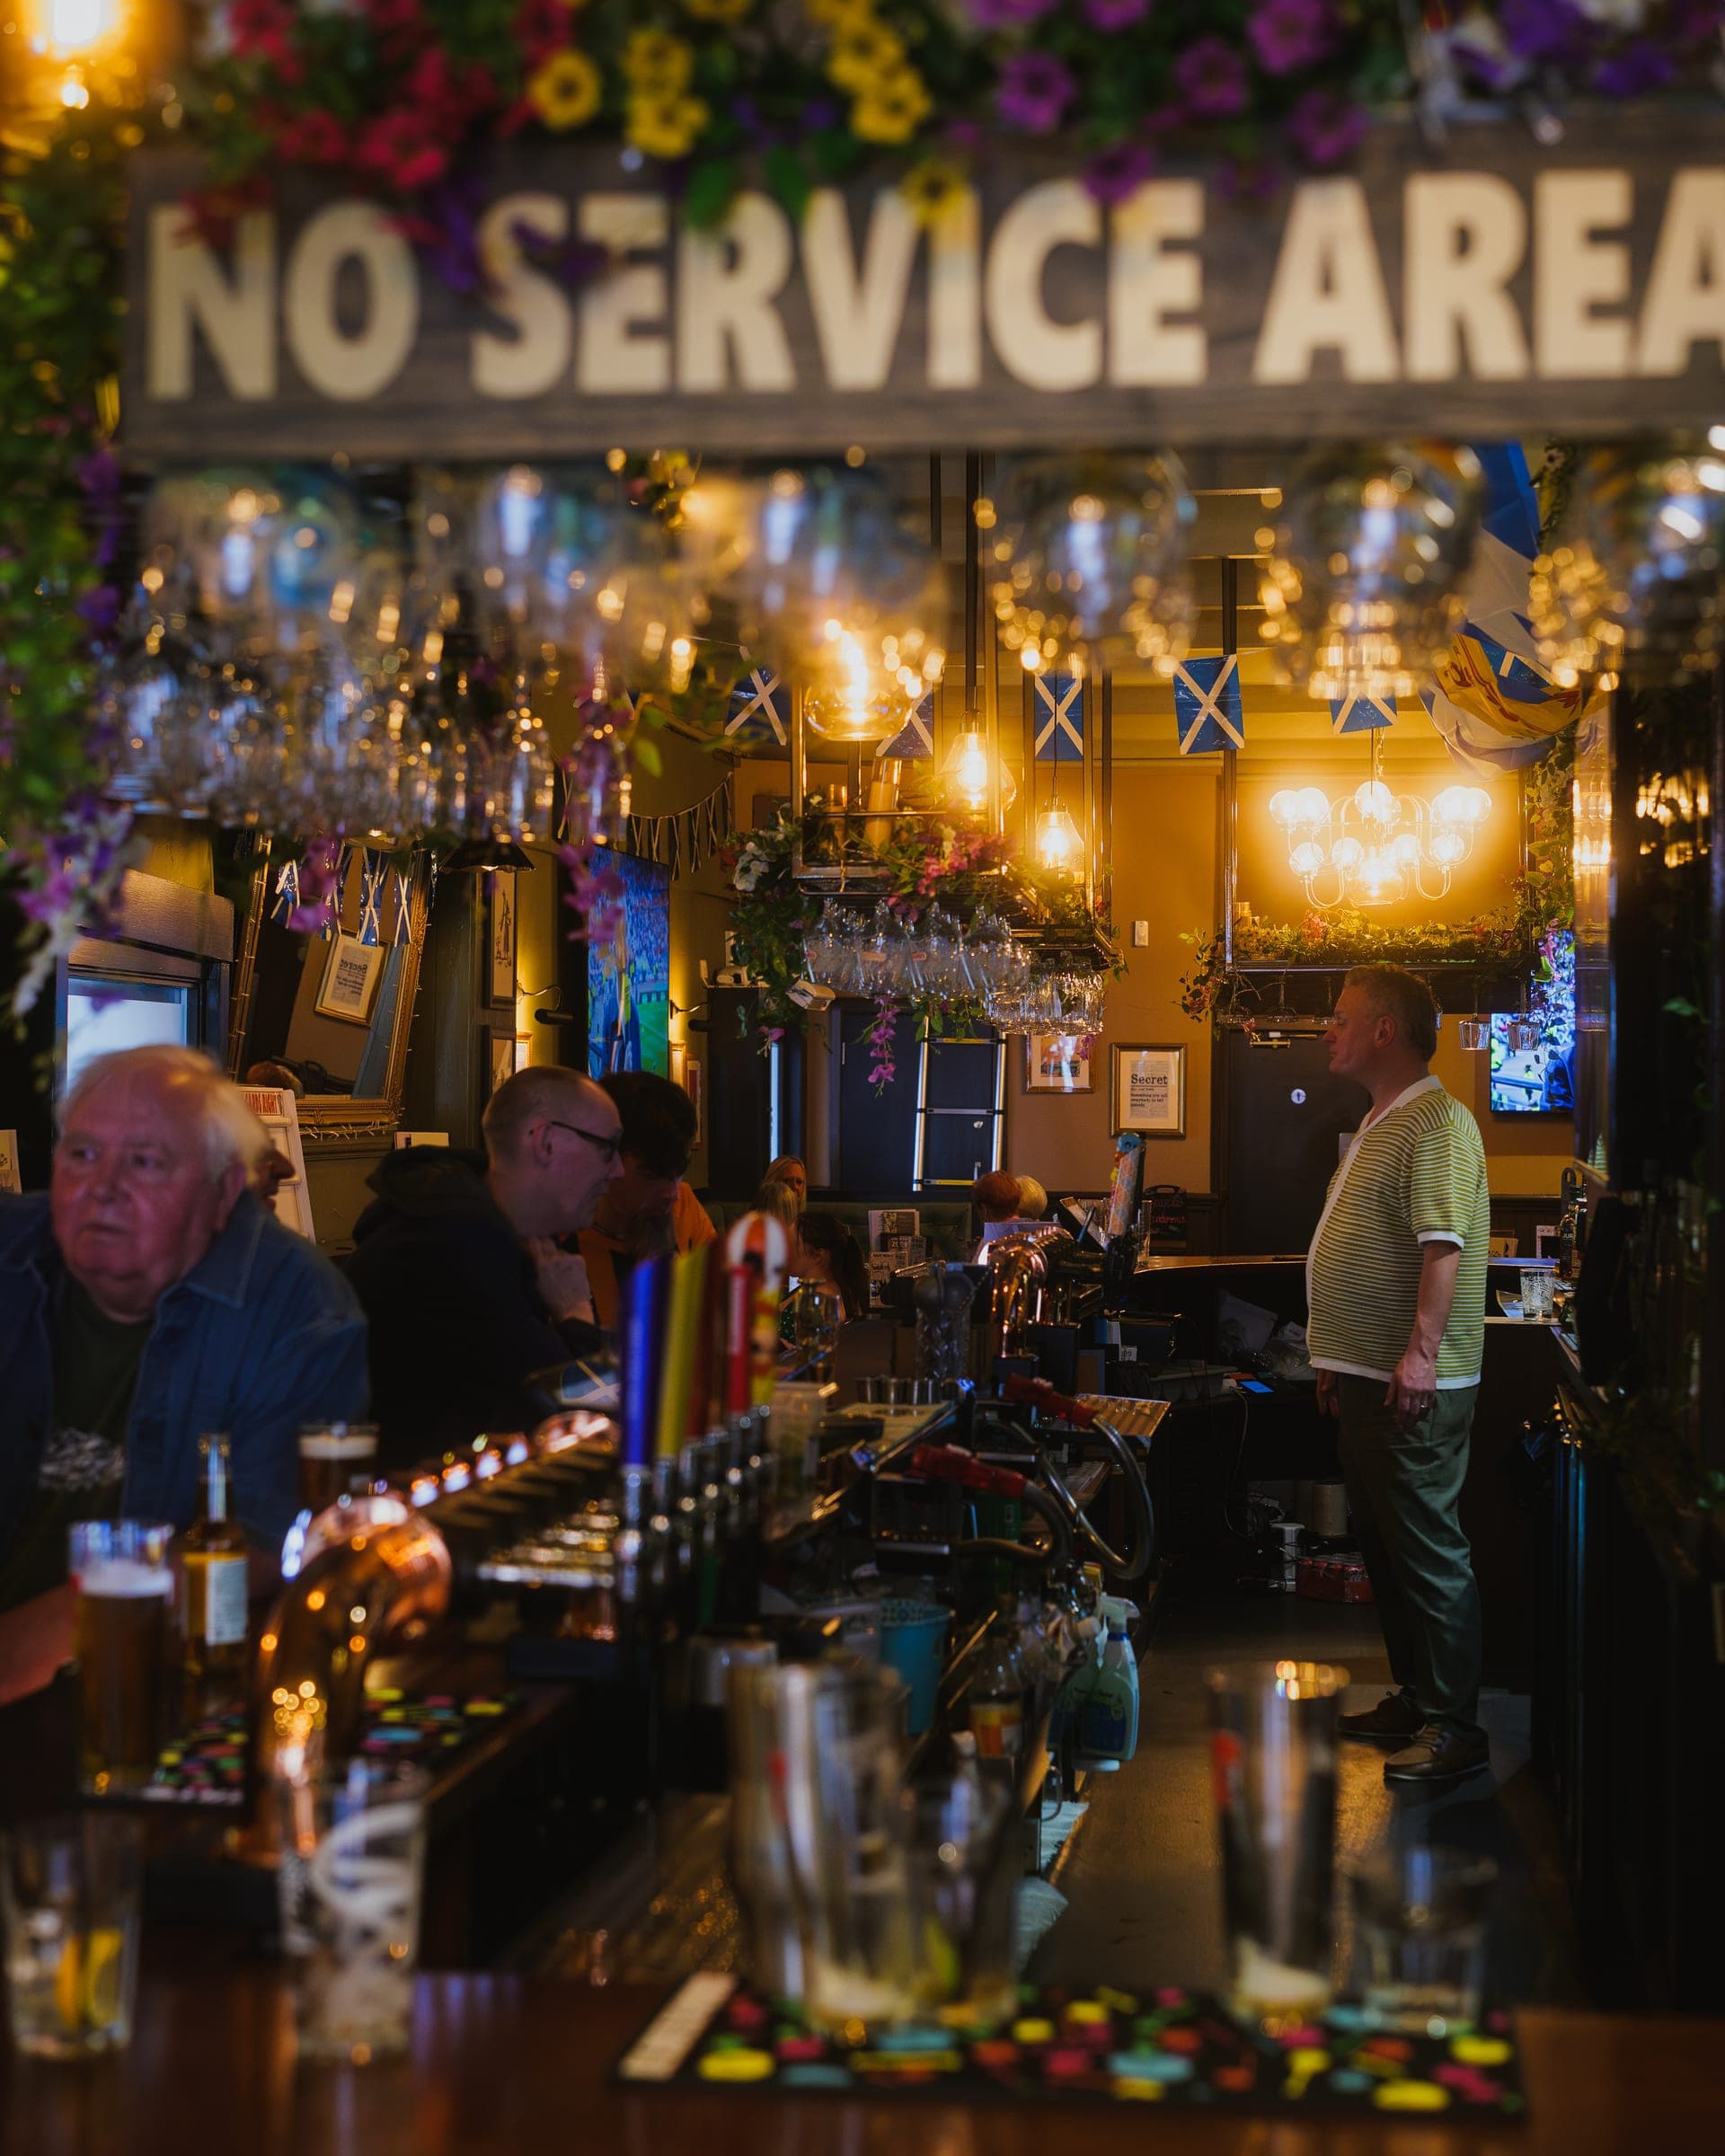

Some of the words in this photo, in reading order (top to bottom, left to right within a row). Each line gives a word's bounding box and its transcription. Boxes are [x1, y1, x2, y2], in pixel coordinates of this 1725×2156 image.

[146, 199, 420, 403] NO
[468, 177, 1208, 398] SERVICE
[1253, 167, 1725, 386] AREA
[1131, 1074, 1168, 1084] Secret
